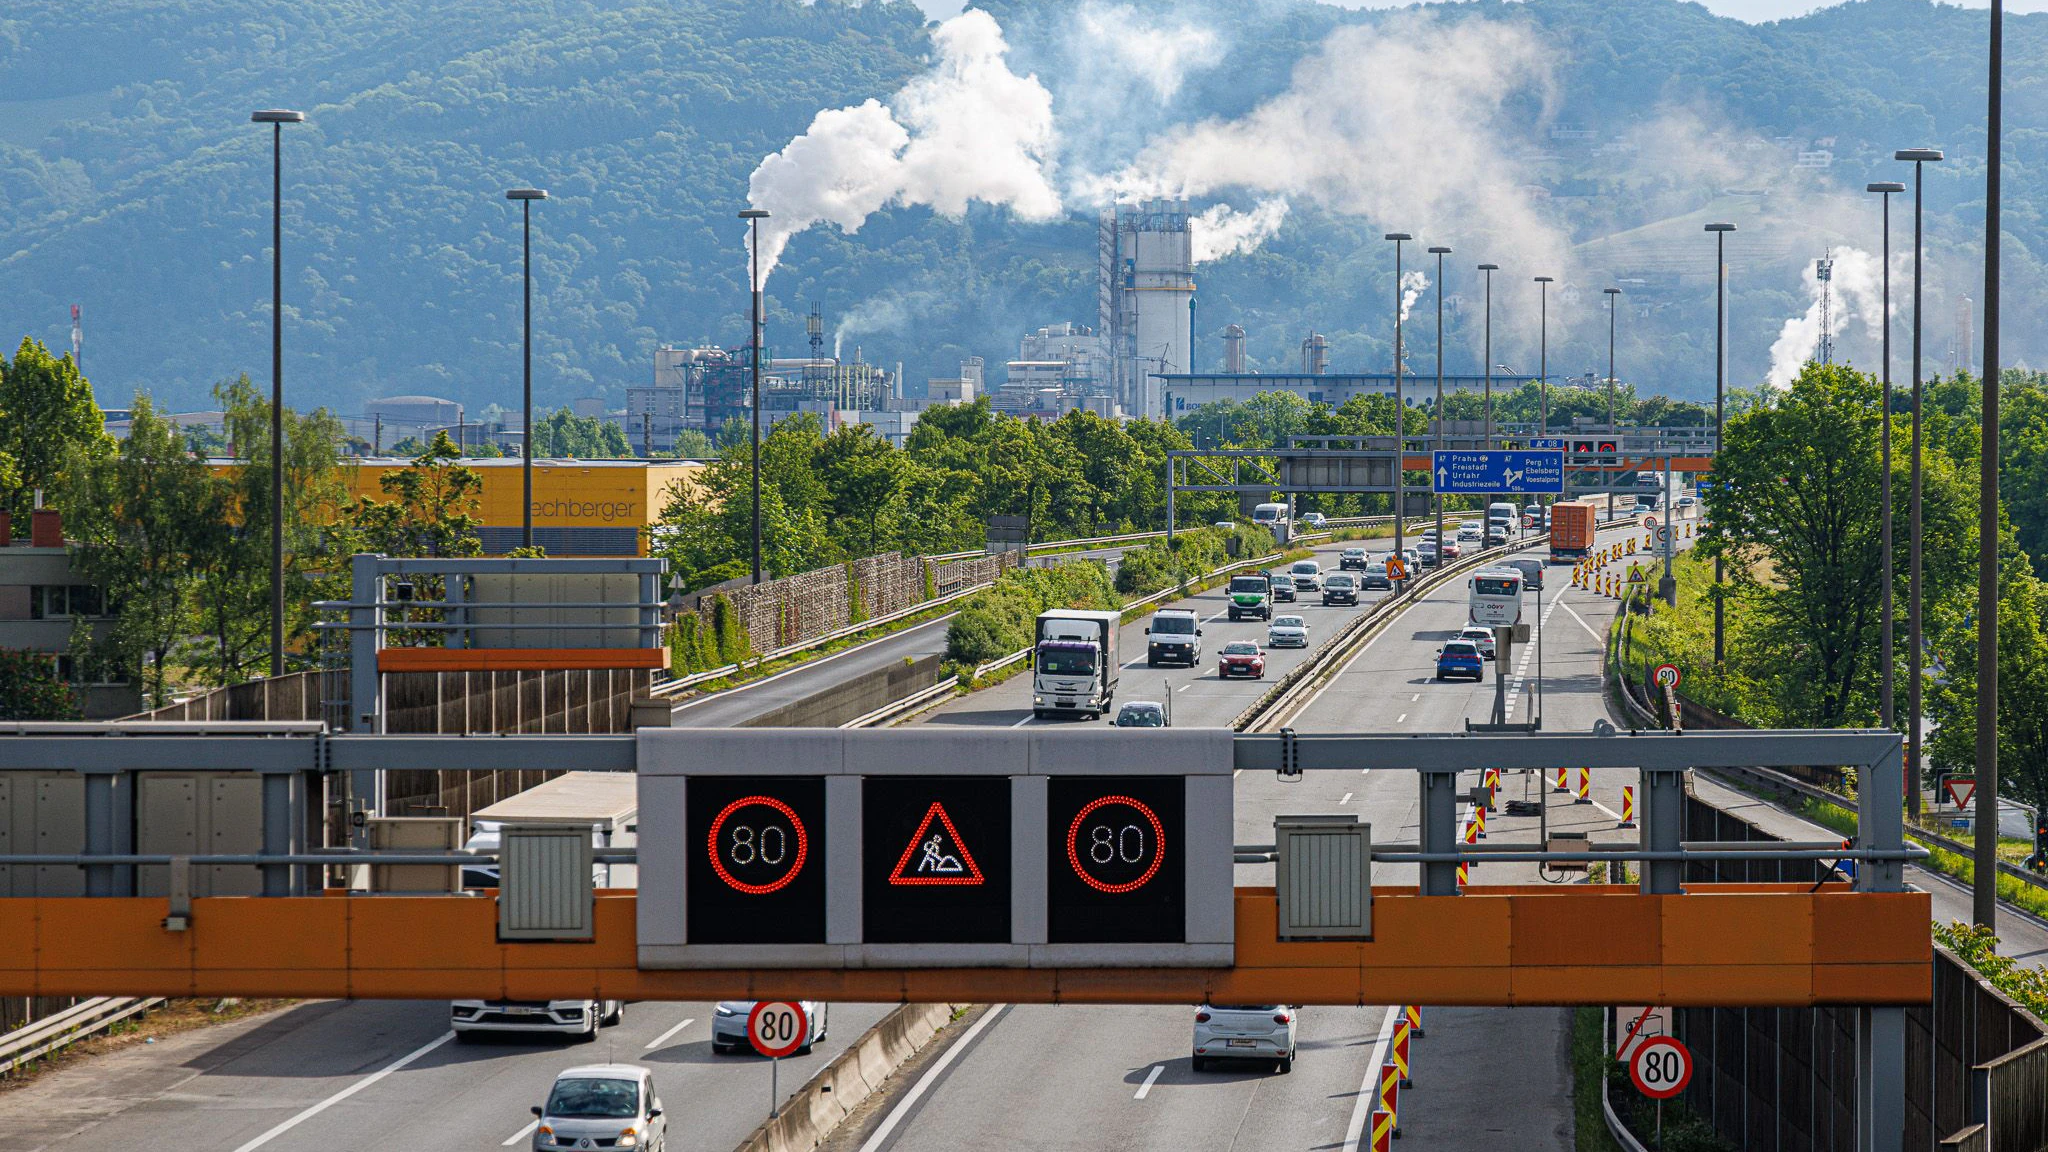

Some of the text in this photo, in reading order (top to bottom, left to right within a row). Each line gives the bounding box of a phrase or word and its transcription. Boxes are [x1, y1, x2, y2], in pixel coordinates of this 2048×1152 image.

[1526, 459, 1542, 467] Perg
[1526, 467, 1560, 475] Ebelsberg
[530, 498, 636, 522] echberger
[731, 825, 785, 864] 80
[1090, 825, 1143, 863] 80
[761, 1011, 793, 1041] 80
[1645, 1051, 1679, 1083] 80
